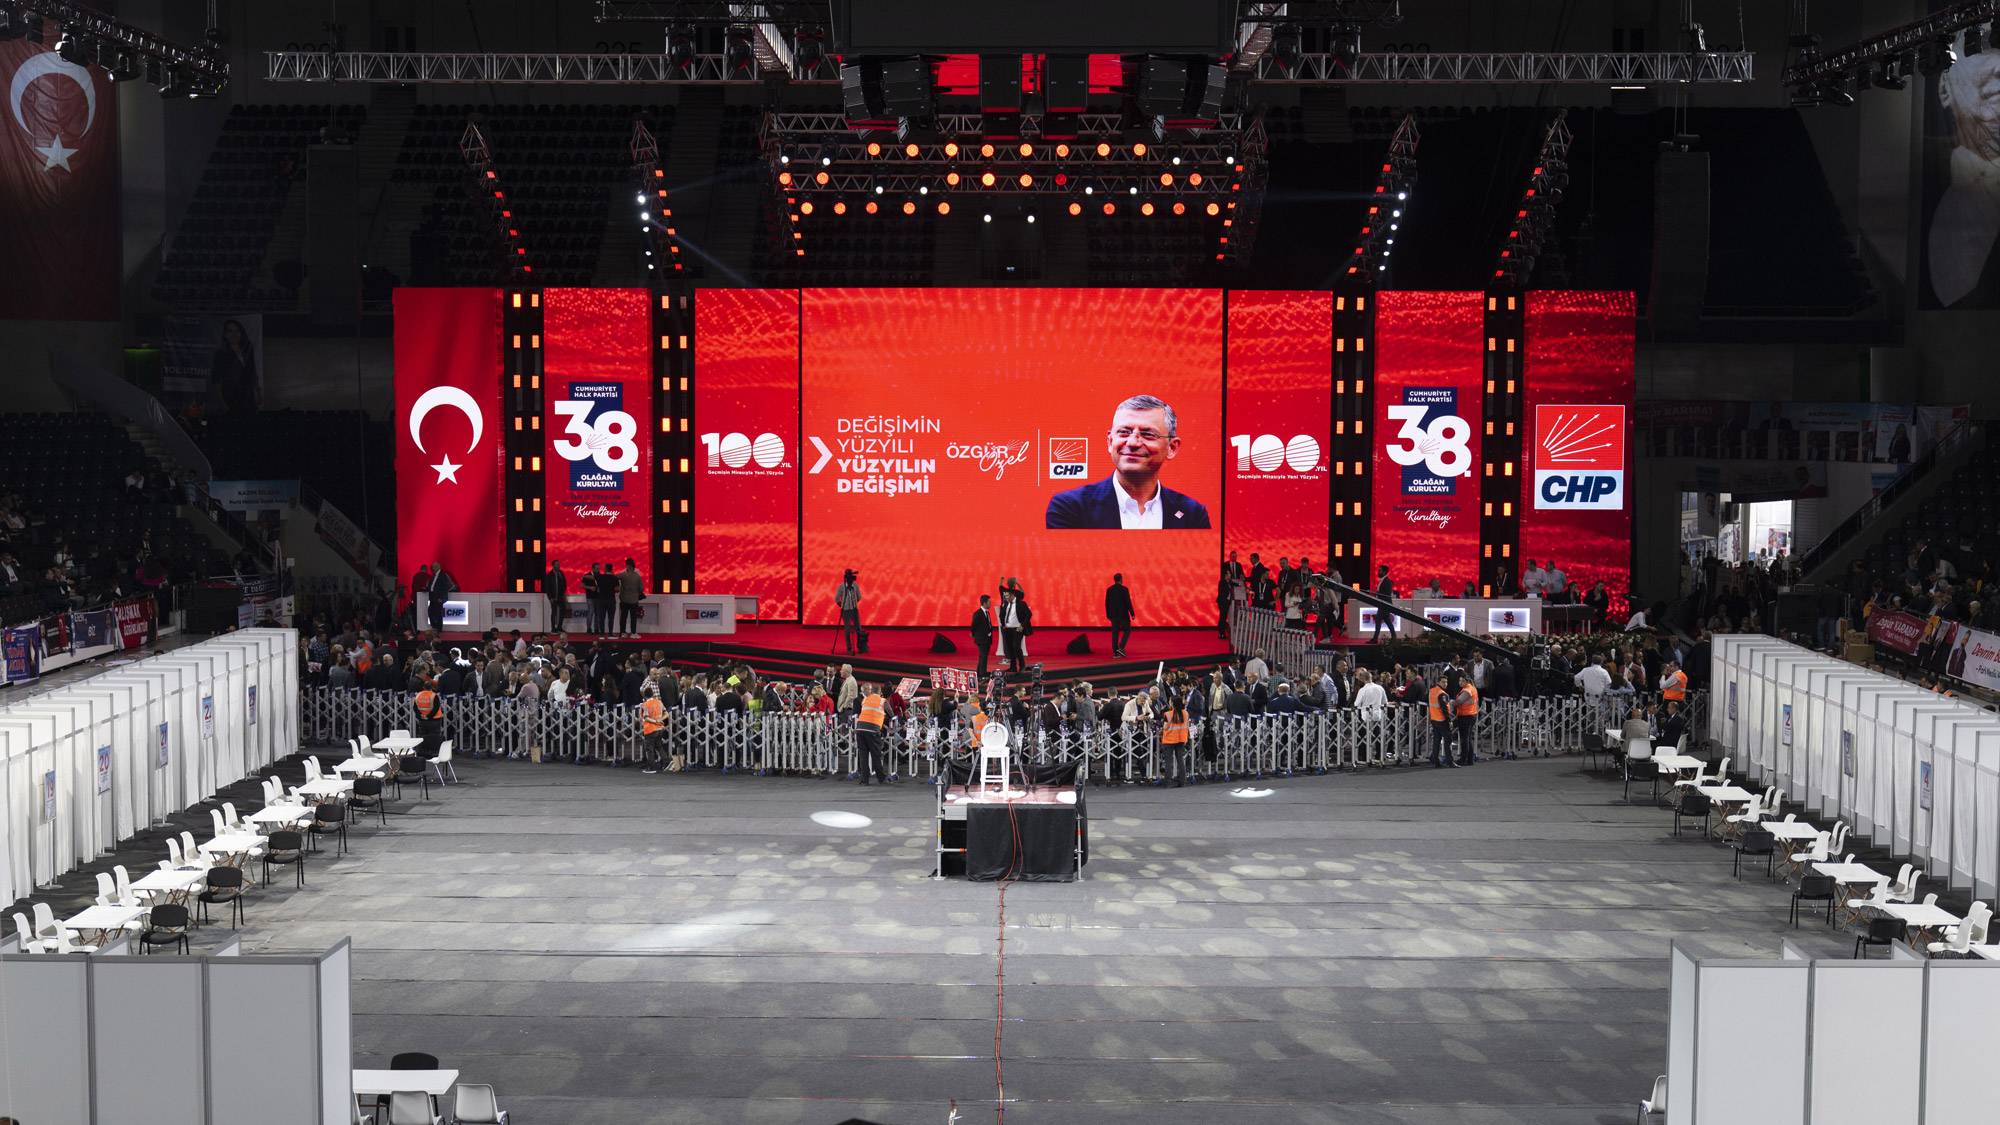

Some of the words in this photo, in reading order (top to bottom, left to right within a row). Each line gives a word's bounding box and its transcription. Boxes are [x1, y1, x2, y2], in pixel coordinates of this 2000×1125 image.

[837, 415, 941, 438] DEĞİŞİMİN
[837, 435, 914, 453] YÜZYILI
[946, 442, 1009, 459] ÖZGÜR
[837, 454, 936, 473] YÜZYILIN
[1053, 464, 1084, 476] CHP
[580, 473, 613, 481] OLAĞAN
[1412, 478, 1445, 486] OLAĞAN
[837, 474, 929, 498] DEĞİŞİMİ
[1541, 475, 1617, 503] CHP
[446, 607, 465, 617] CHP
[700, 609, 719, 619] CHP
[1441, 615, 1461, 624] CHP
[1971, 642, 1996, 661] Devrim
[1785, 711, 1791, 727] 2
[99, 753, 110, 773] 20
[1923, 770, 1929, 788] 4
